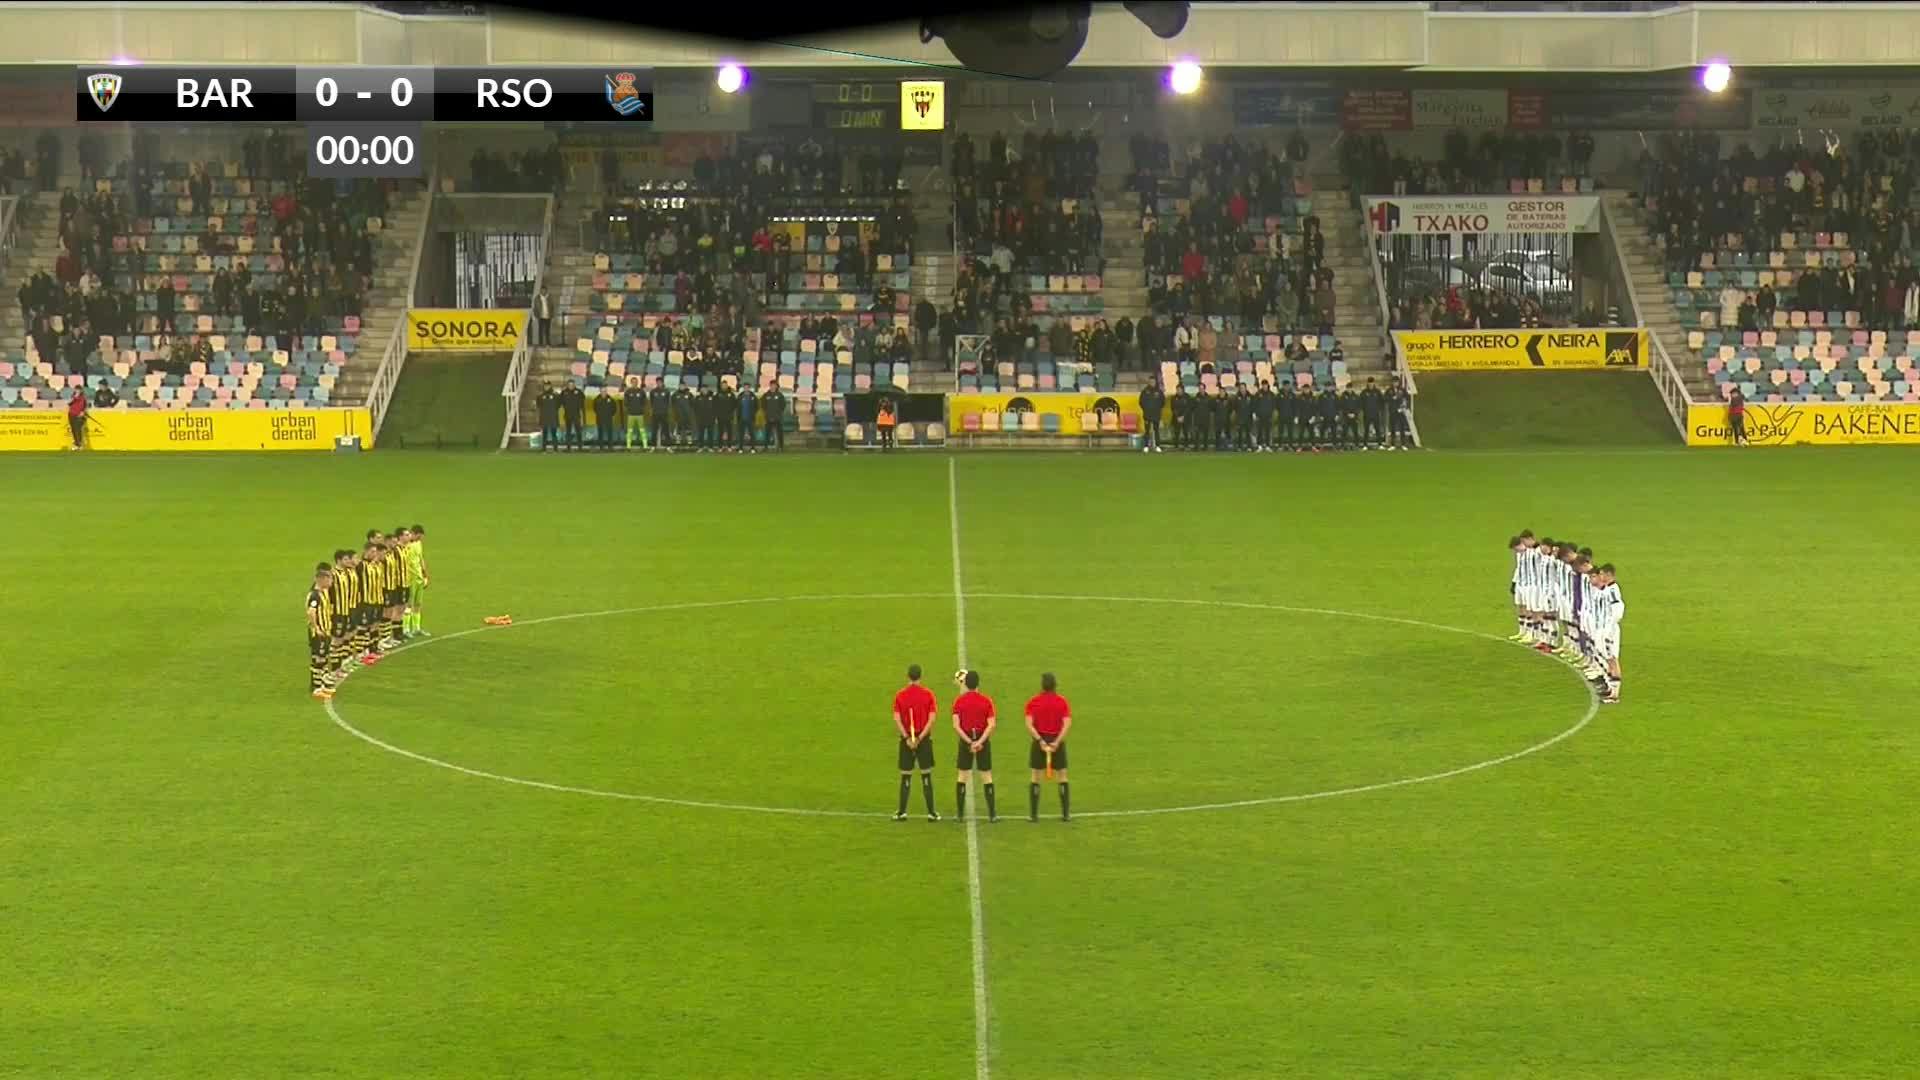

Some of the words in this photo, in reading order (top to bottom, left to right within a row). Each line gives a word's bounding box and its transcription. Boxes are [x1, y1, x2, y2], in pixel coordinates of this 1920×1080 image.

[1508, 201, 1565, 212] GESTOR
[1412, 215, 1489, 232] TXAKO
[416, 321, 518, 338] SONORA
[1406, 342, 1435, 352] grupo
[1439, 334, 1519, 349] HERRERO
[1548, 334, 1600, 348] NEIRA
[168, 412, 213, 431] urban
[271, 412, 316, 431] urban
[1815, 413, 1920, 435] BAKENE
[169, 424, 213, 441] dental
[272, 424, 316, 441] dental
[1695, 424, 1739, 440] Grup
[1760, 424, 1787, 437] Pau
